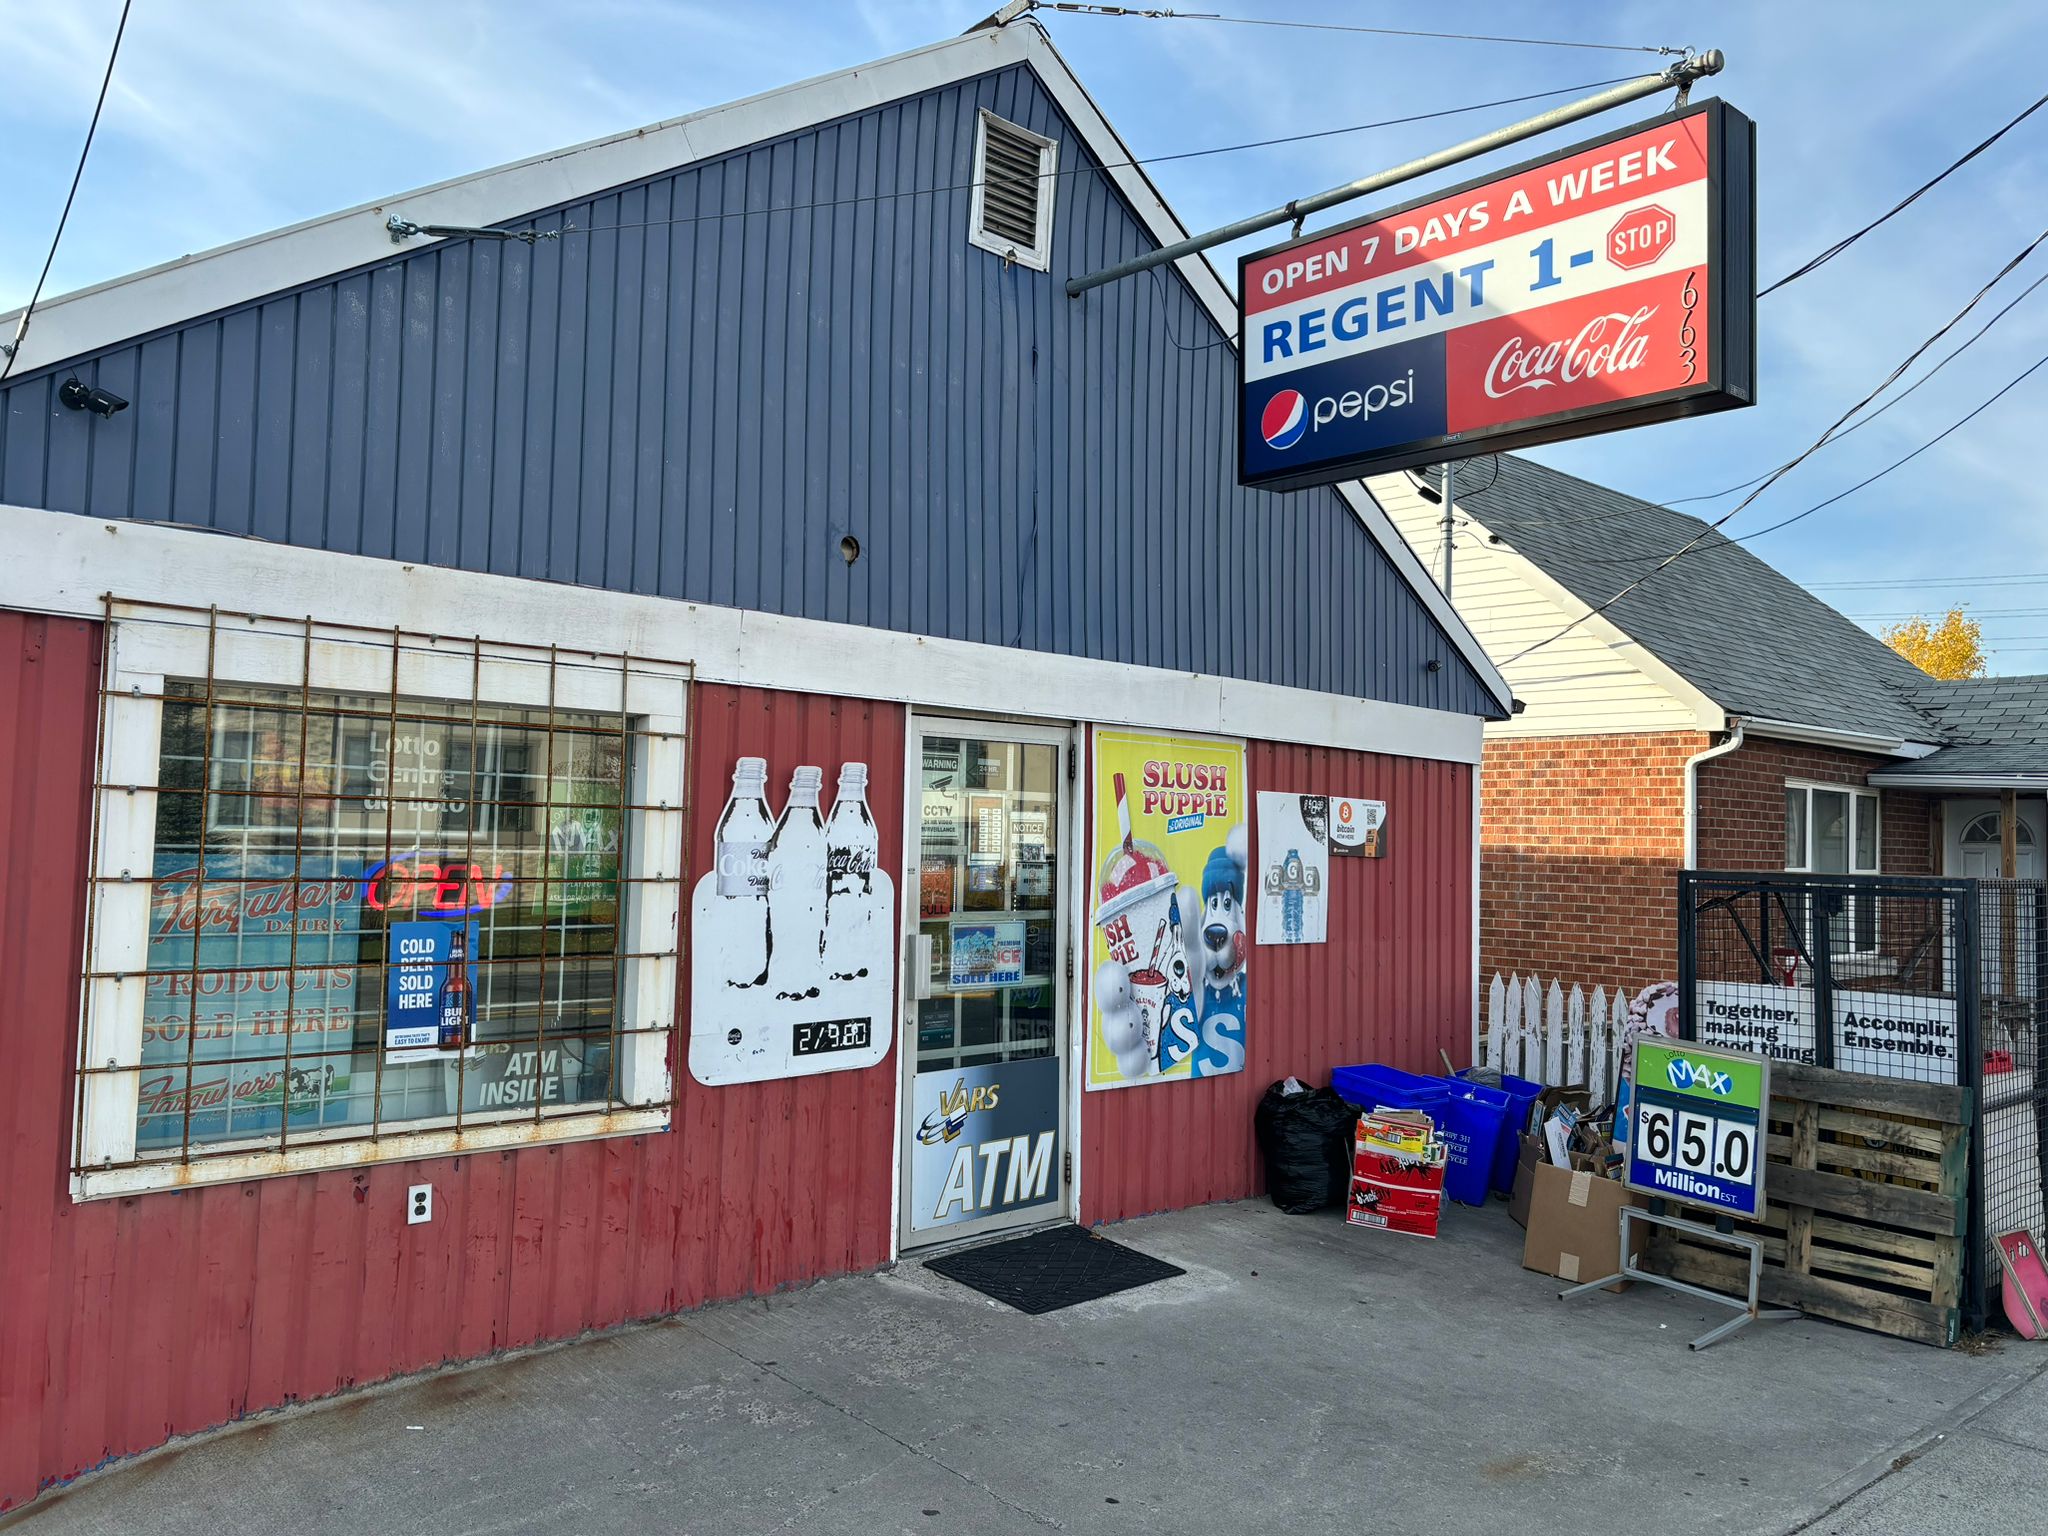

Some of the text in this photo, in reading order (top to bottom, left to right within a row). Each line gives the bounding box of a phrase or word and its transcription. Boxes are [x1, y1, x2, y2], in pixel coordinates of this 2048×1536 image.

[1262, 139, 1678, 295] OPEN 7 DAYS A WEEK
[1263, 259, 1494, 363] REGENT
[1615, 219, 1668, 256] STOP
[1484, 304, 1660, 399] Coca-Cola
[1314, 369, 1414, 432] pepsi
[369, 731, 441, 756] Lotto
[367, 760, 455, 785] Centre
[922, 759, 957, 769] WARNING
[1143, 760, 1227, 791] SLUSH
[408, 790, 466, 814] Loto
[923, 805, 952, 816] CCTV
[1143, 791, 1227, 816] PUPPiE
[1013, 823, 1043, 832] NOTICE
[1336, 824, 1355, 834] bitcoin
[367, 862, 503, 911] OPEN
[920, 905, 946, 915] PULL
[264, 919, 346, 932] DAIRY
[400, 938, 435, 955] COLD
[996, 949, 1021, 963] ICE
[144, 962, 353, 998] PRODUCTS
[399, 975, 434, 992] SOLD
[952, 971, 1020, 984] SOLD HERE
[398, 992, 433, 1010] HERE
[1705, 1000, 1799, 1026] Together,
[142, 1006, 350, 1043] SOLD HERE
[1705, 1021, 1779, 1043] making
[1843, 1011, 1955, 1038] Accomplir.
[394, 1038, 408, 1046] EASY
[414, 1036, 430, 1044] ENJOY
[1843, 1030, 1954, 1059] Ensemble.
[504, 1050, 558, 1077] ATM
[1666, 1059, 1729, 1096] MAX
[480, 1076, 559, 1106] INSIDE
[939, 1078, 1001, 1117] VARS
[933, 1129, 1056, 1220] ATM
[1655, 1168, 1738, 1205] Million EST.
